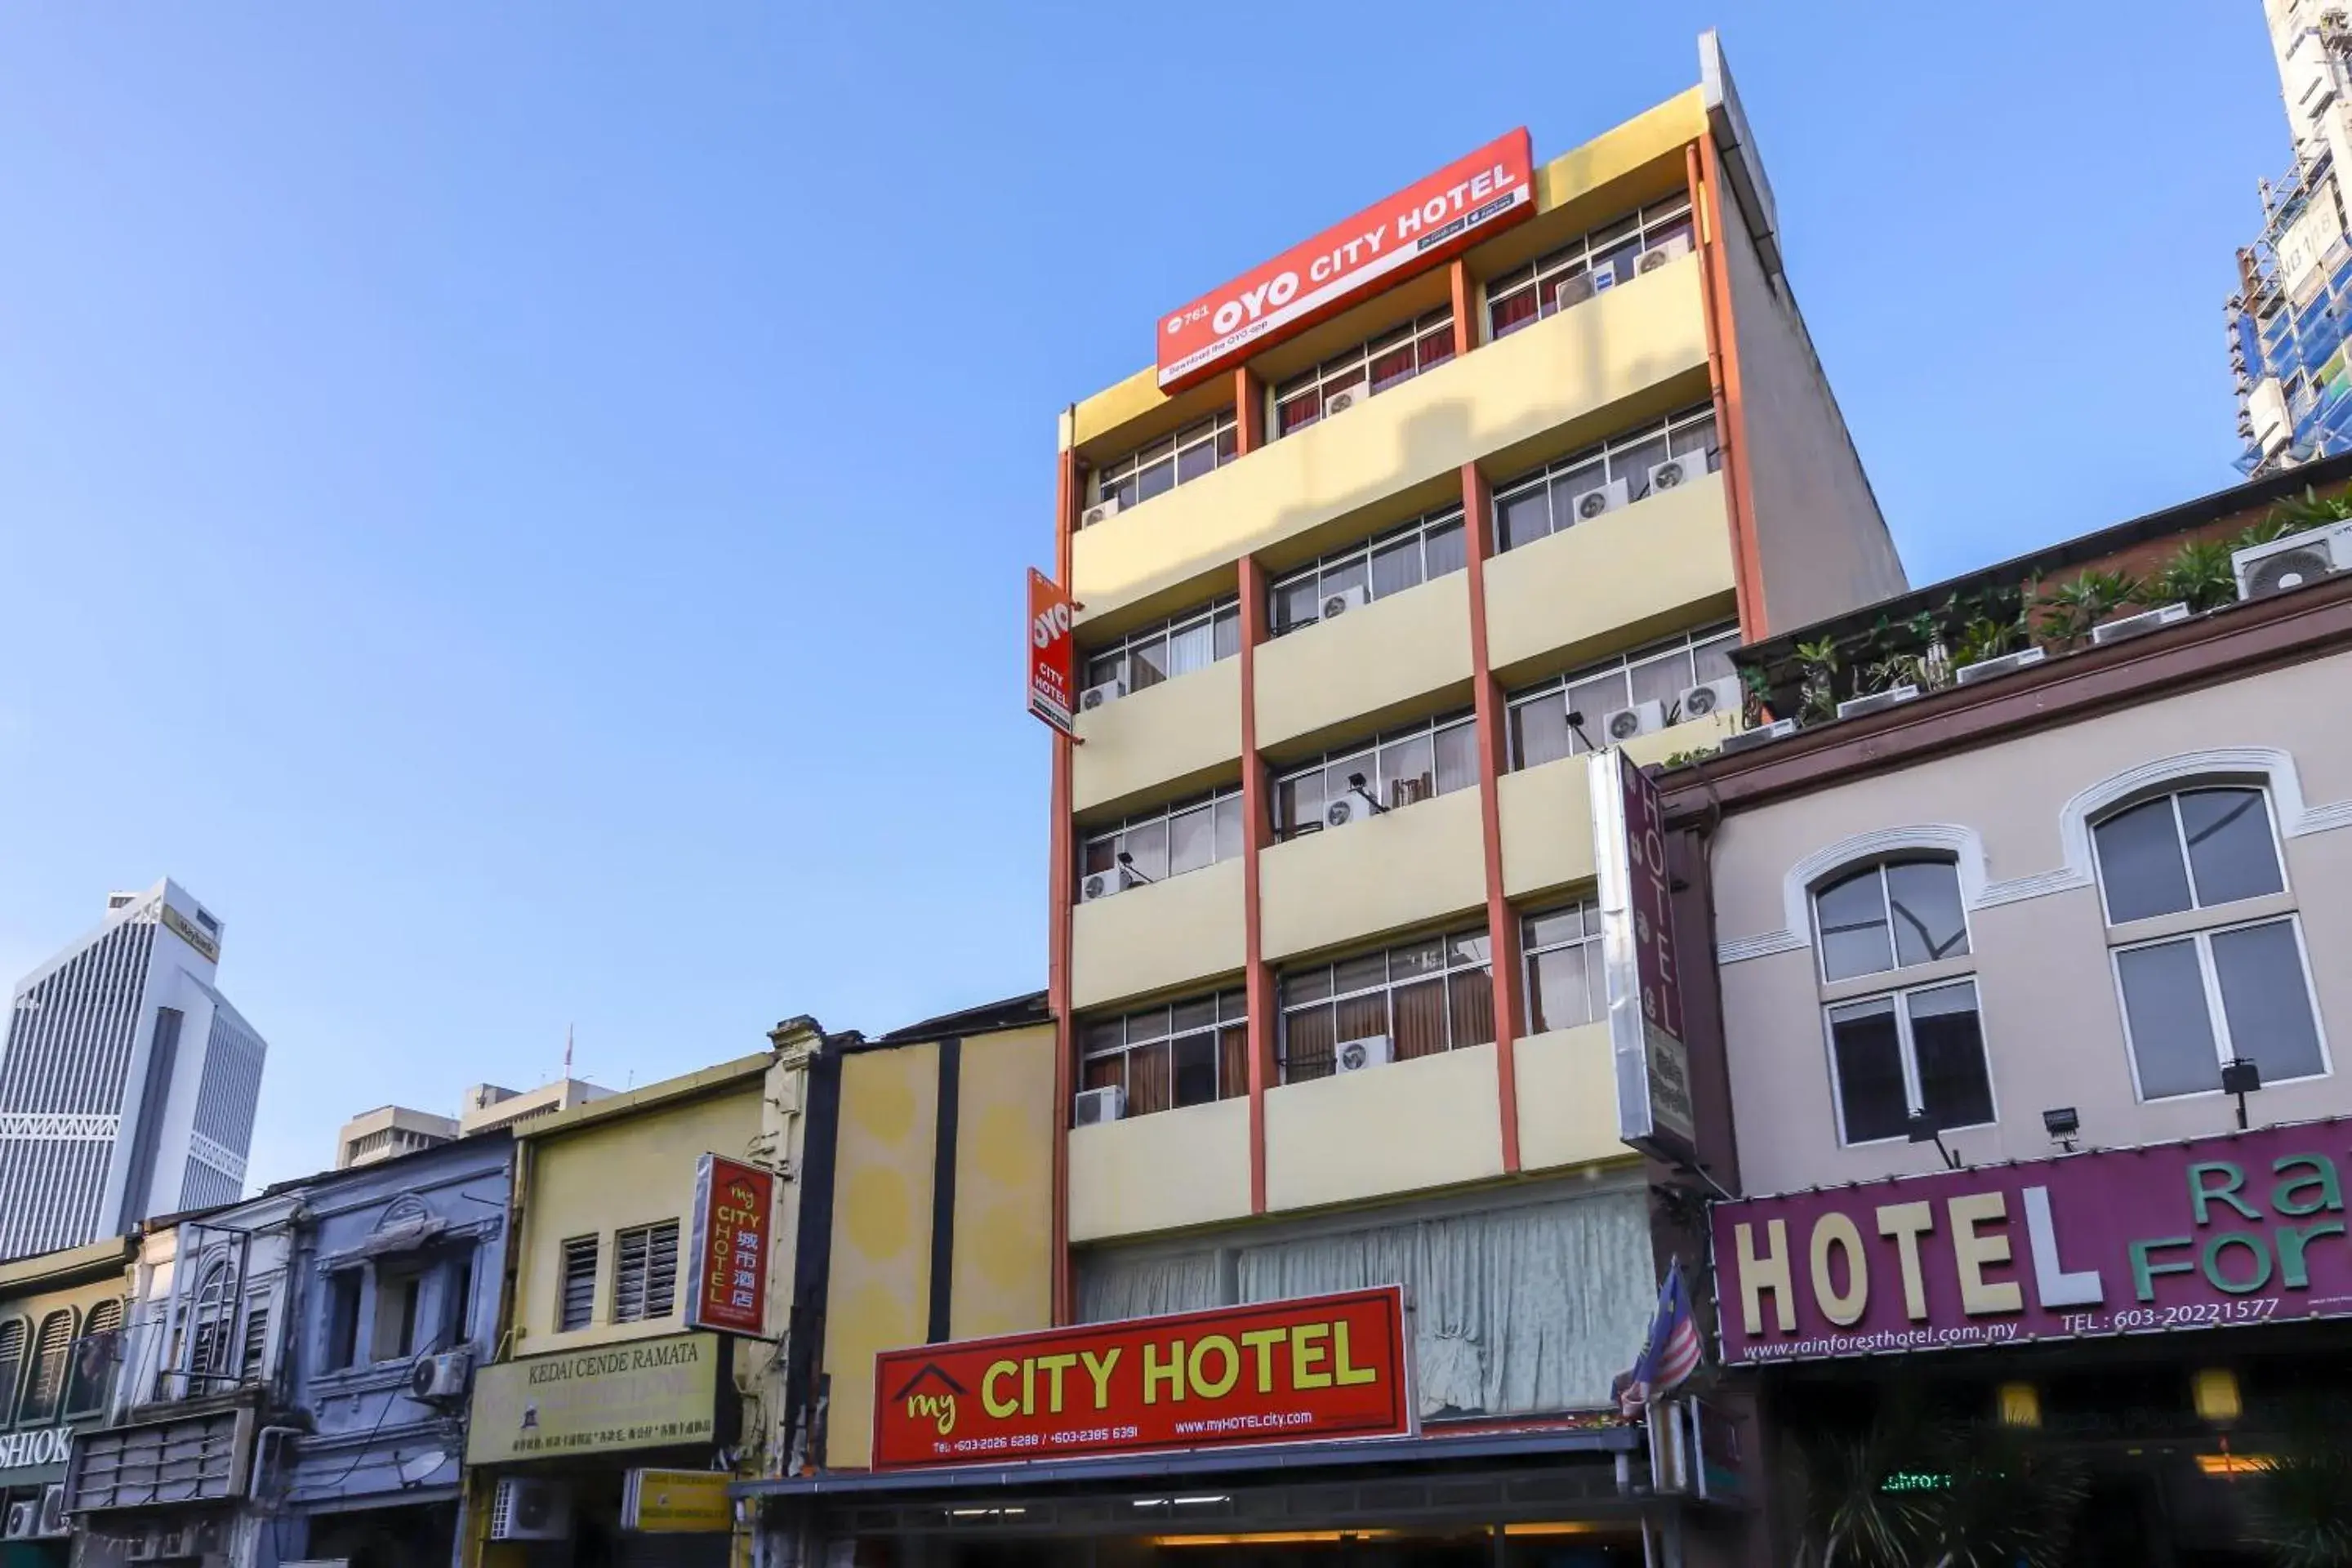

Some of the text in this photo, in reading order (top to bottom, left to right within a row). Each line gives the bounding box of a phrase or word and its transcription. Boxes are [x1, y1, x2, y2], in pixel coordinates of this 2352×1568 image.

[1213, 164, 1516, 335] OYO CITY HOTEL
[1184, 305, 1209, 325] 761
[1033, 602, 1068, 648] OYO
[1035, 675, 1068, 707] HOTEL
[1040, 662, 1063, 686] CITY
[1641, 777, 1678, 1037] HOTEL
[717, 1205, 761, 1227] CITY
[731, 1187, 755, 1209] my
[709, 1223, 731, 1303] HOTEL
[732, 1230, 758, 1307] 城市酒店
[1735, 1186, 2103, 1334] HOTEL
[2061, 1313, 2098, 1331] TEL
[2114, 1298, 2279, 1327] 603-20221577
[1742, 1321, 2018, 1359] www.rainforesthotel.com.my
[529, 1342, 699, 1385] KEDAI CENDE RAMATA
[982, 1320, 1376, 1419] CITY HOTEL
[907, 1392, 956, 1436] my
